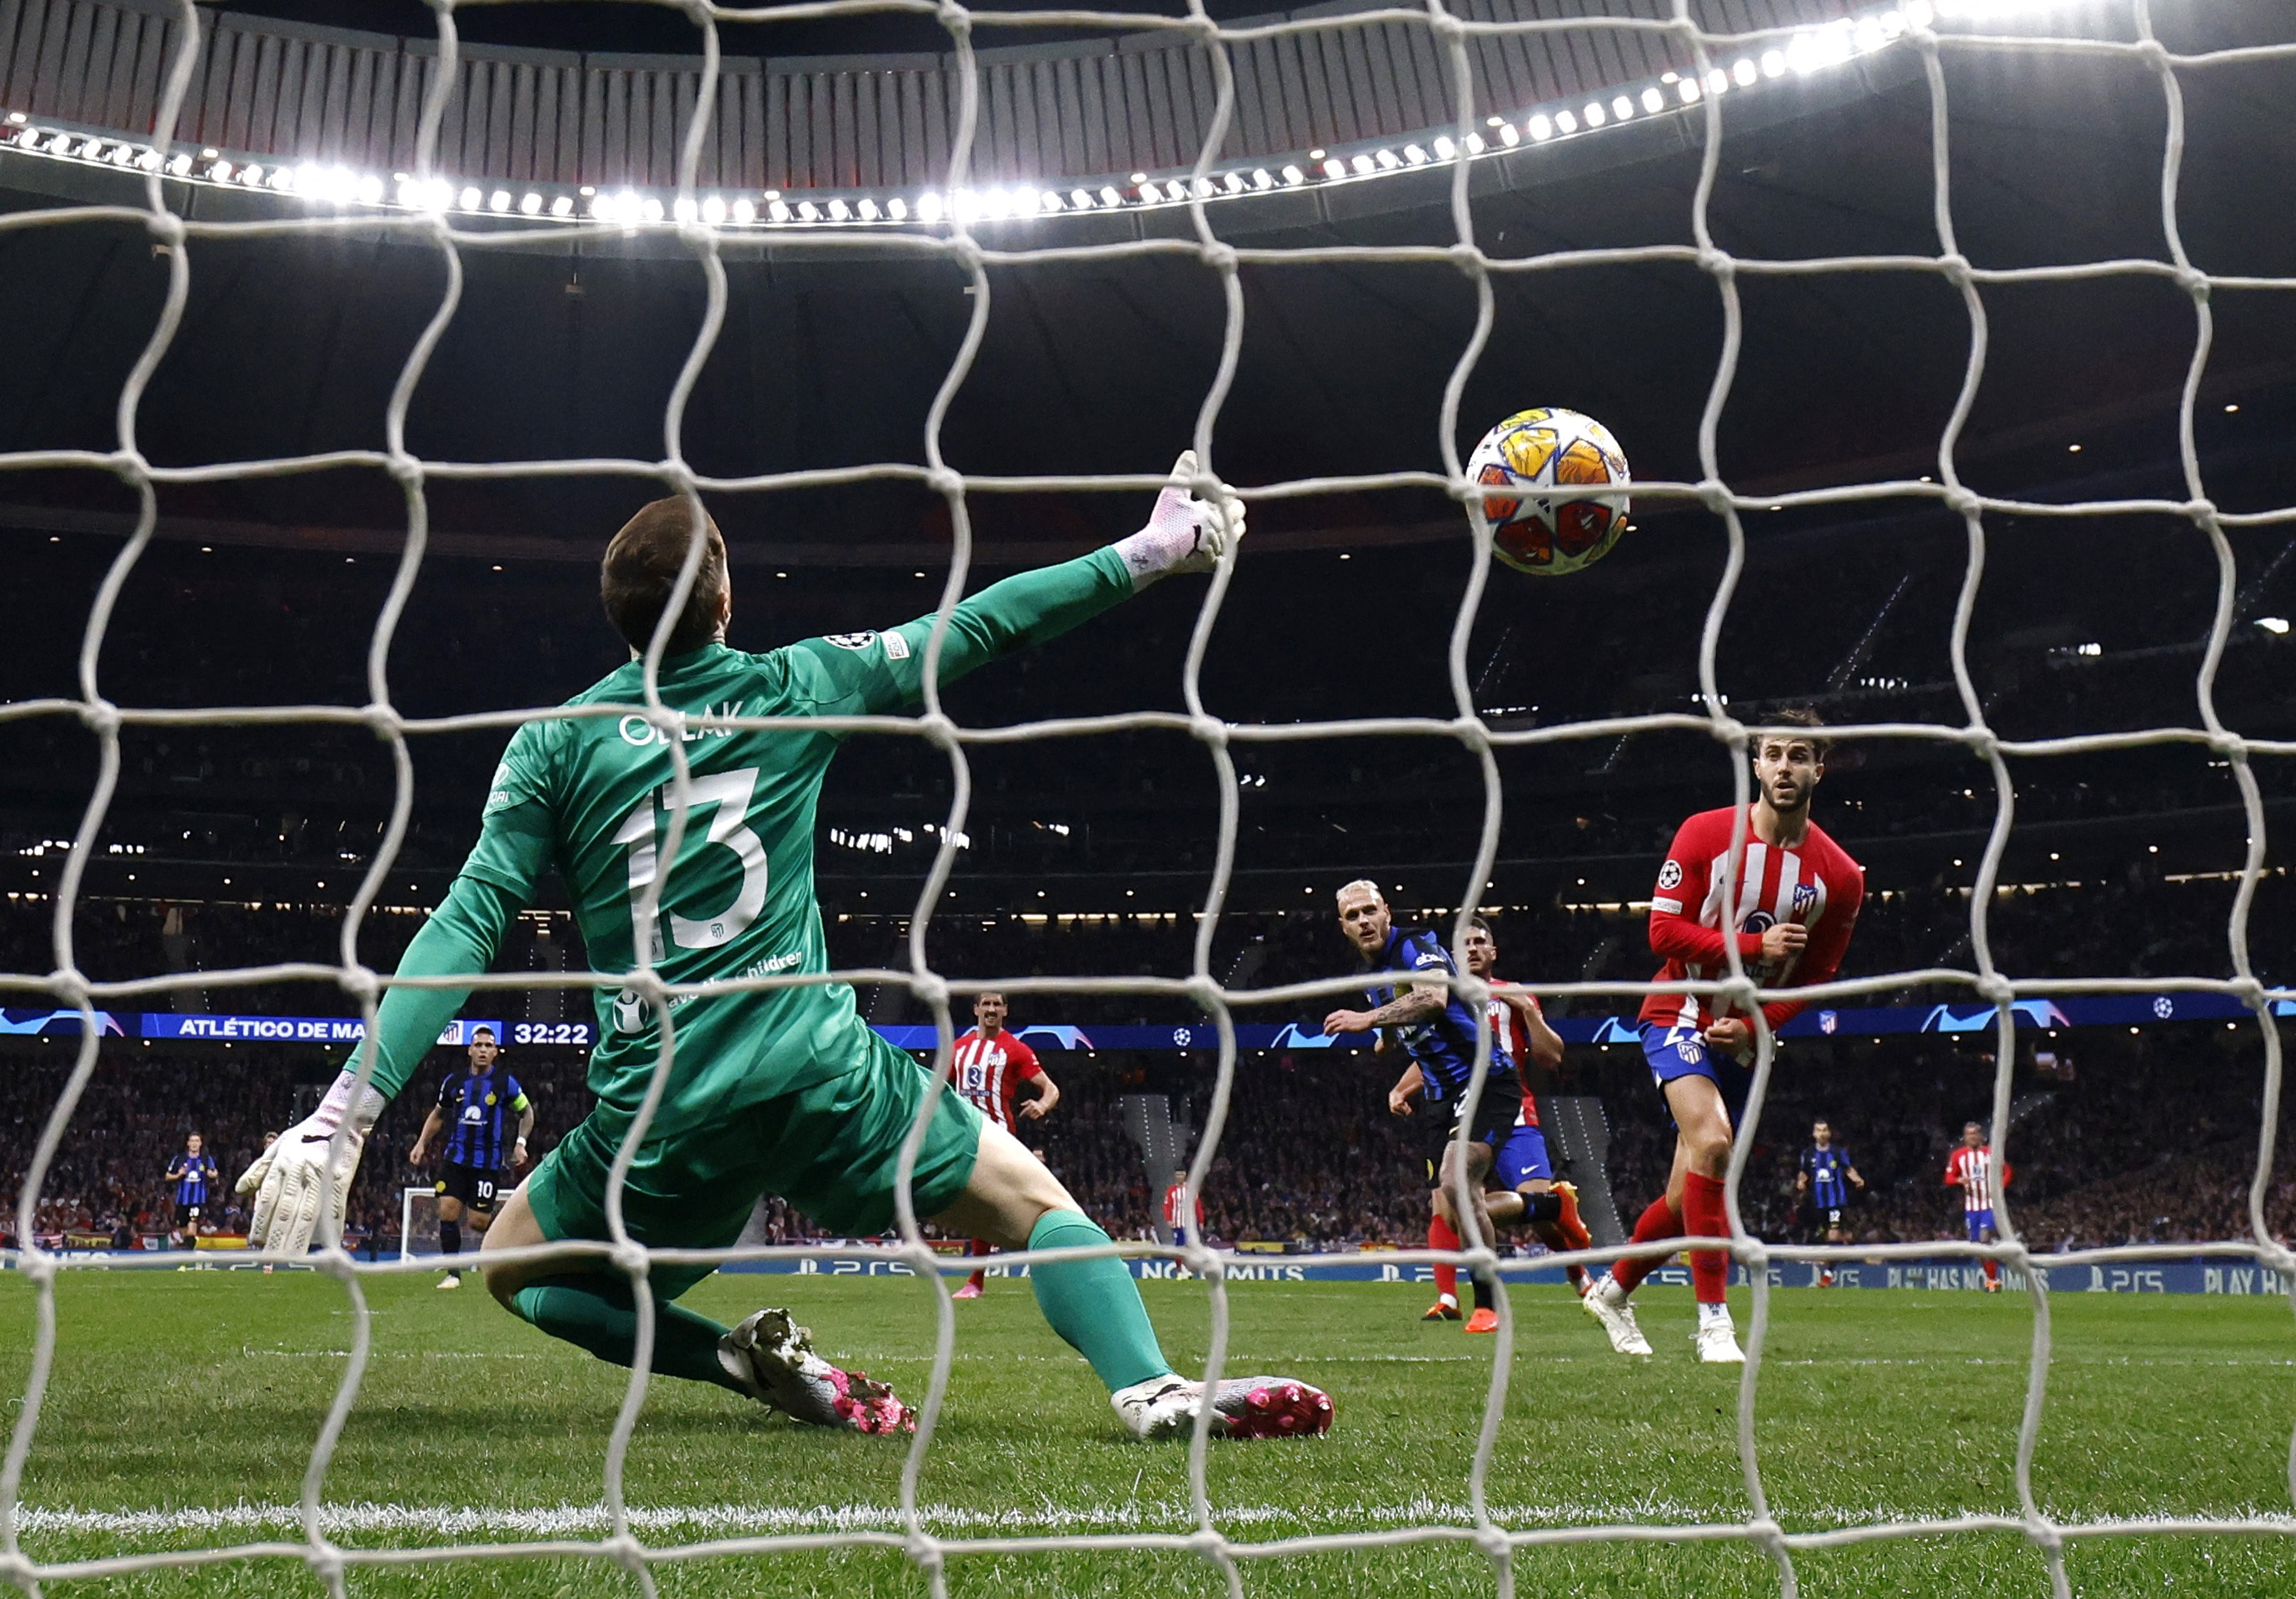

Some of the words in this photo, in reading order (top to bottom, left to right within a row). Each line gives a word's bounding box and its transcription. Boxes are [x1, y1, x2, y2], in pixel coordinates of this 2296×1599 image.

[610, 767, 768, 963] 13
[179, 1017, 294, 1038] ATLÉTICO
[297, 1022, 328, 1038] DE
[514, 1023, 589, 1045] 32:22
[477, 1180, 493, 1199] 10
[1928, 1267, 1959, 1290] HAS
